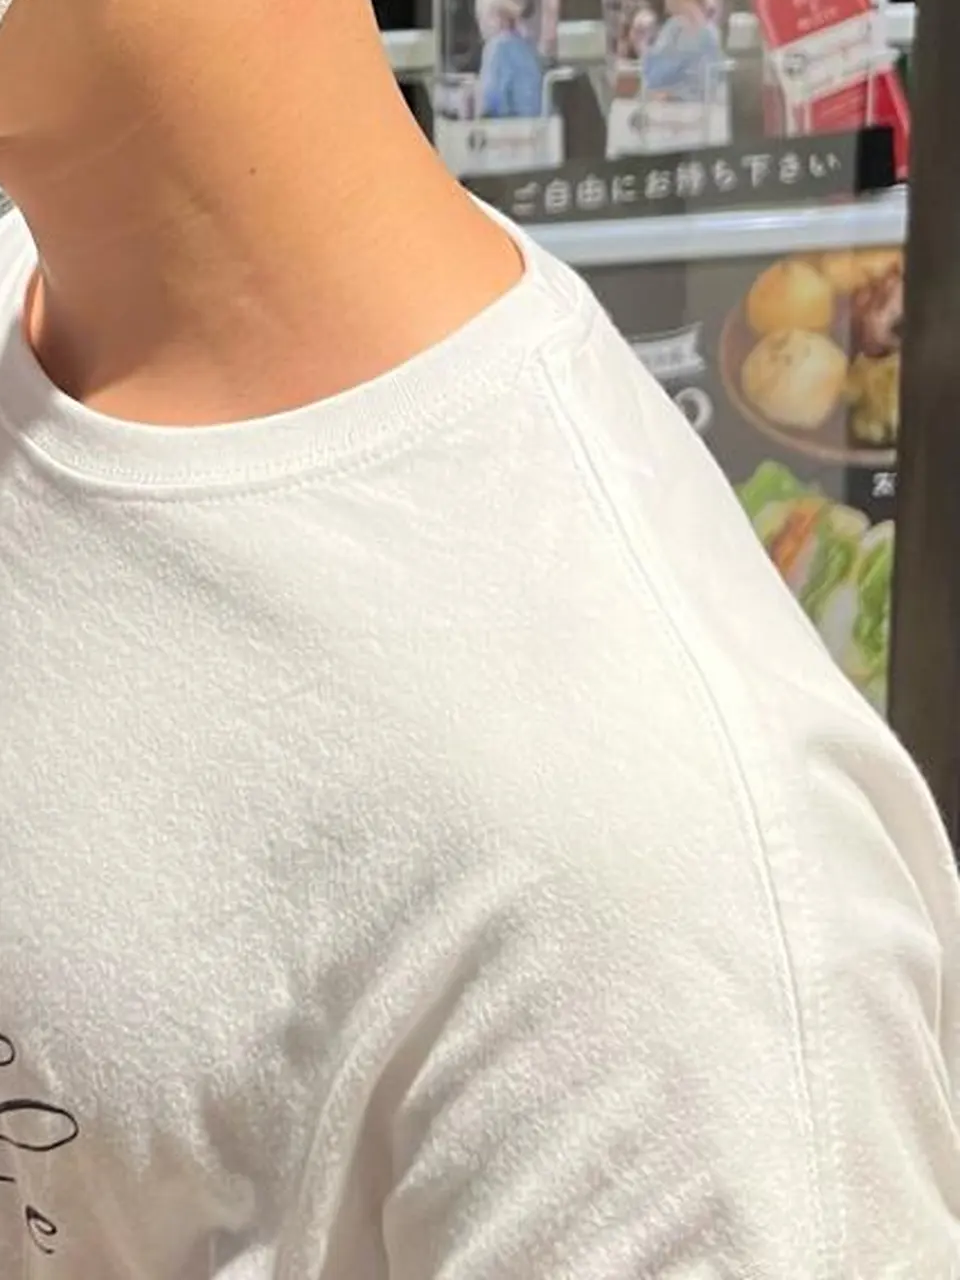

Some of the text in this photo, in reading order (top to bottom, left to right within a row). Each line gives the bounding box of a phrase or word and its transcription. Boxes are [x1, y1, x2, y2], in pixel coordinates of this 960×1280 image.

[512, 152, 841, 216] ご自由にお持ち下さい
